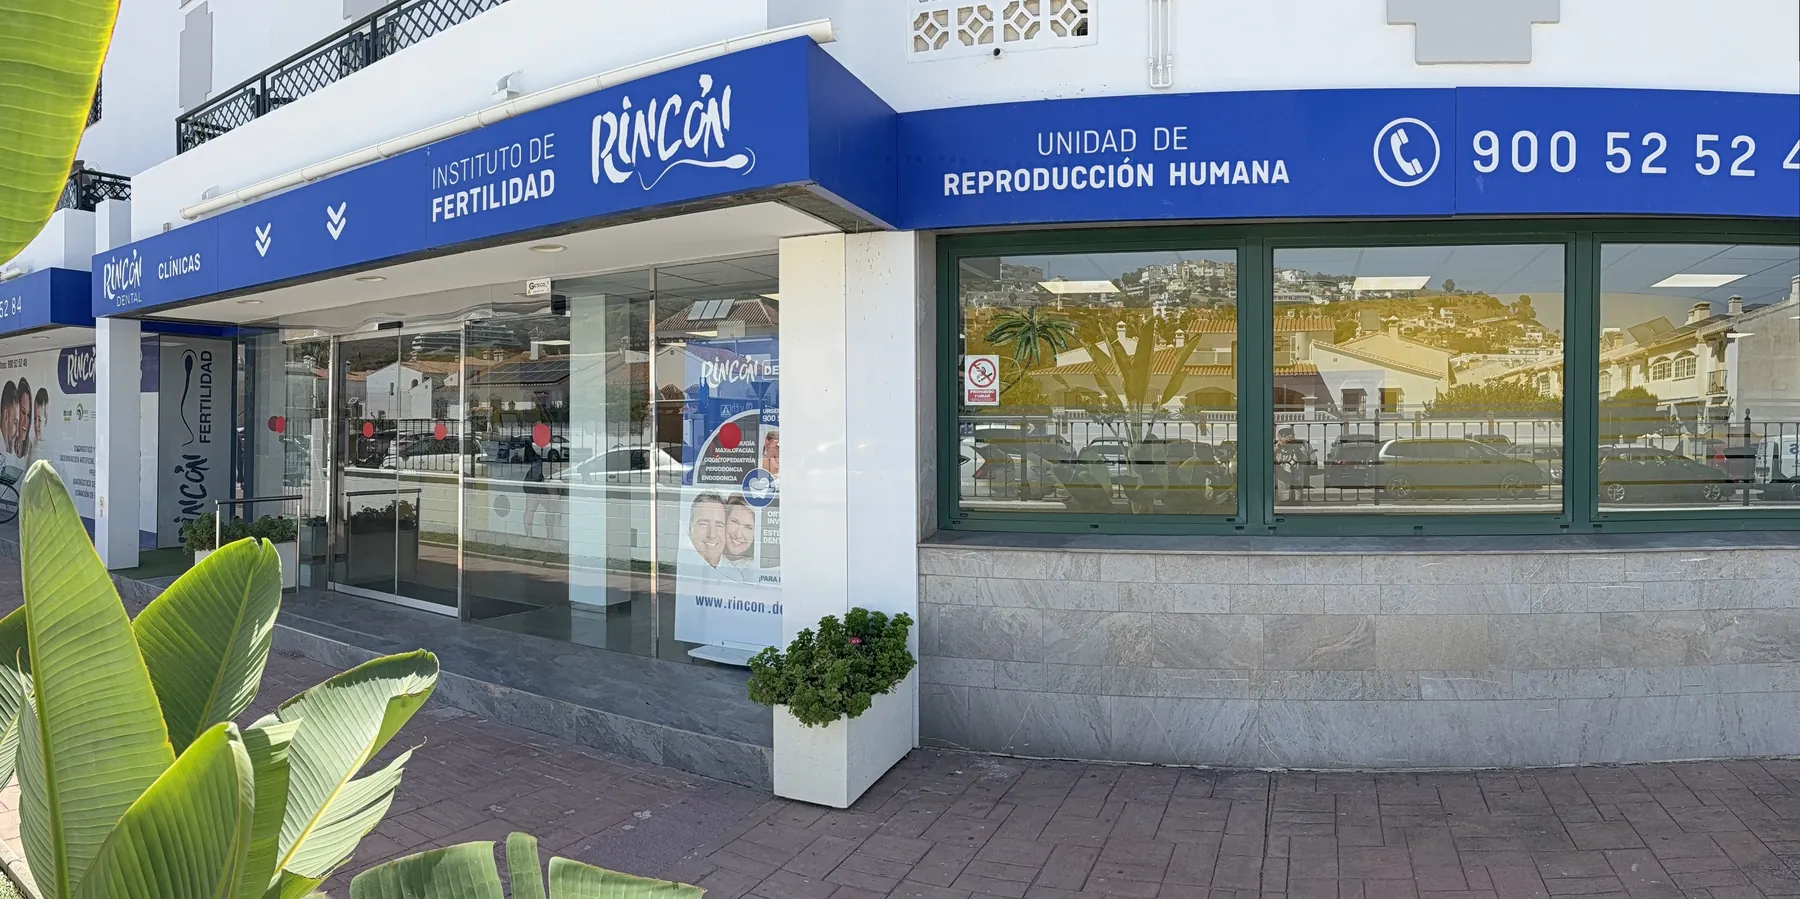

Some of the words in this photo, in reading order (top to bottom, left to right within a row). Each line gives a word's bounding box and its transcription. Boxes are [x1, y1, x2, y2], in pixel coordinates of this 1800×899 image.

[1037, 126, 1137, 156] UNIDAD
[1153, 126, 1188, 151] DE
[1472, 130, 1577, 173] 900
[1605, 131, 1668, 174] 52
[1694, 133, 1757, 177] 52
[432, 144, 522, 190] INSTITUTO
[529, 132, 556, 165] DE
[943, 157, 1154, 196] REPRODUCCIÓN
[1169, 159, 1290, 187] HUMANA
[432, 168, 556, 223] FERTILIDAD
[158, 252, 201, 280] CLÍNICAS
[11, 295, 22, 316] 84
[116, 292, 143, 307] DENTAL
[199, 350, 213, 444] FERTILIDAD
